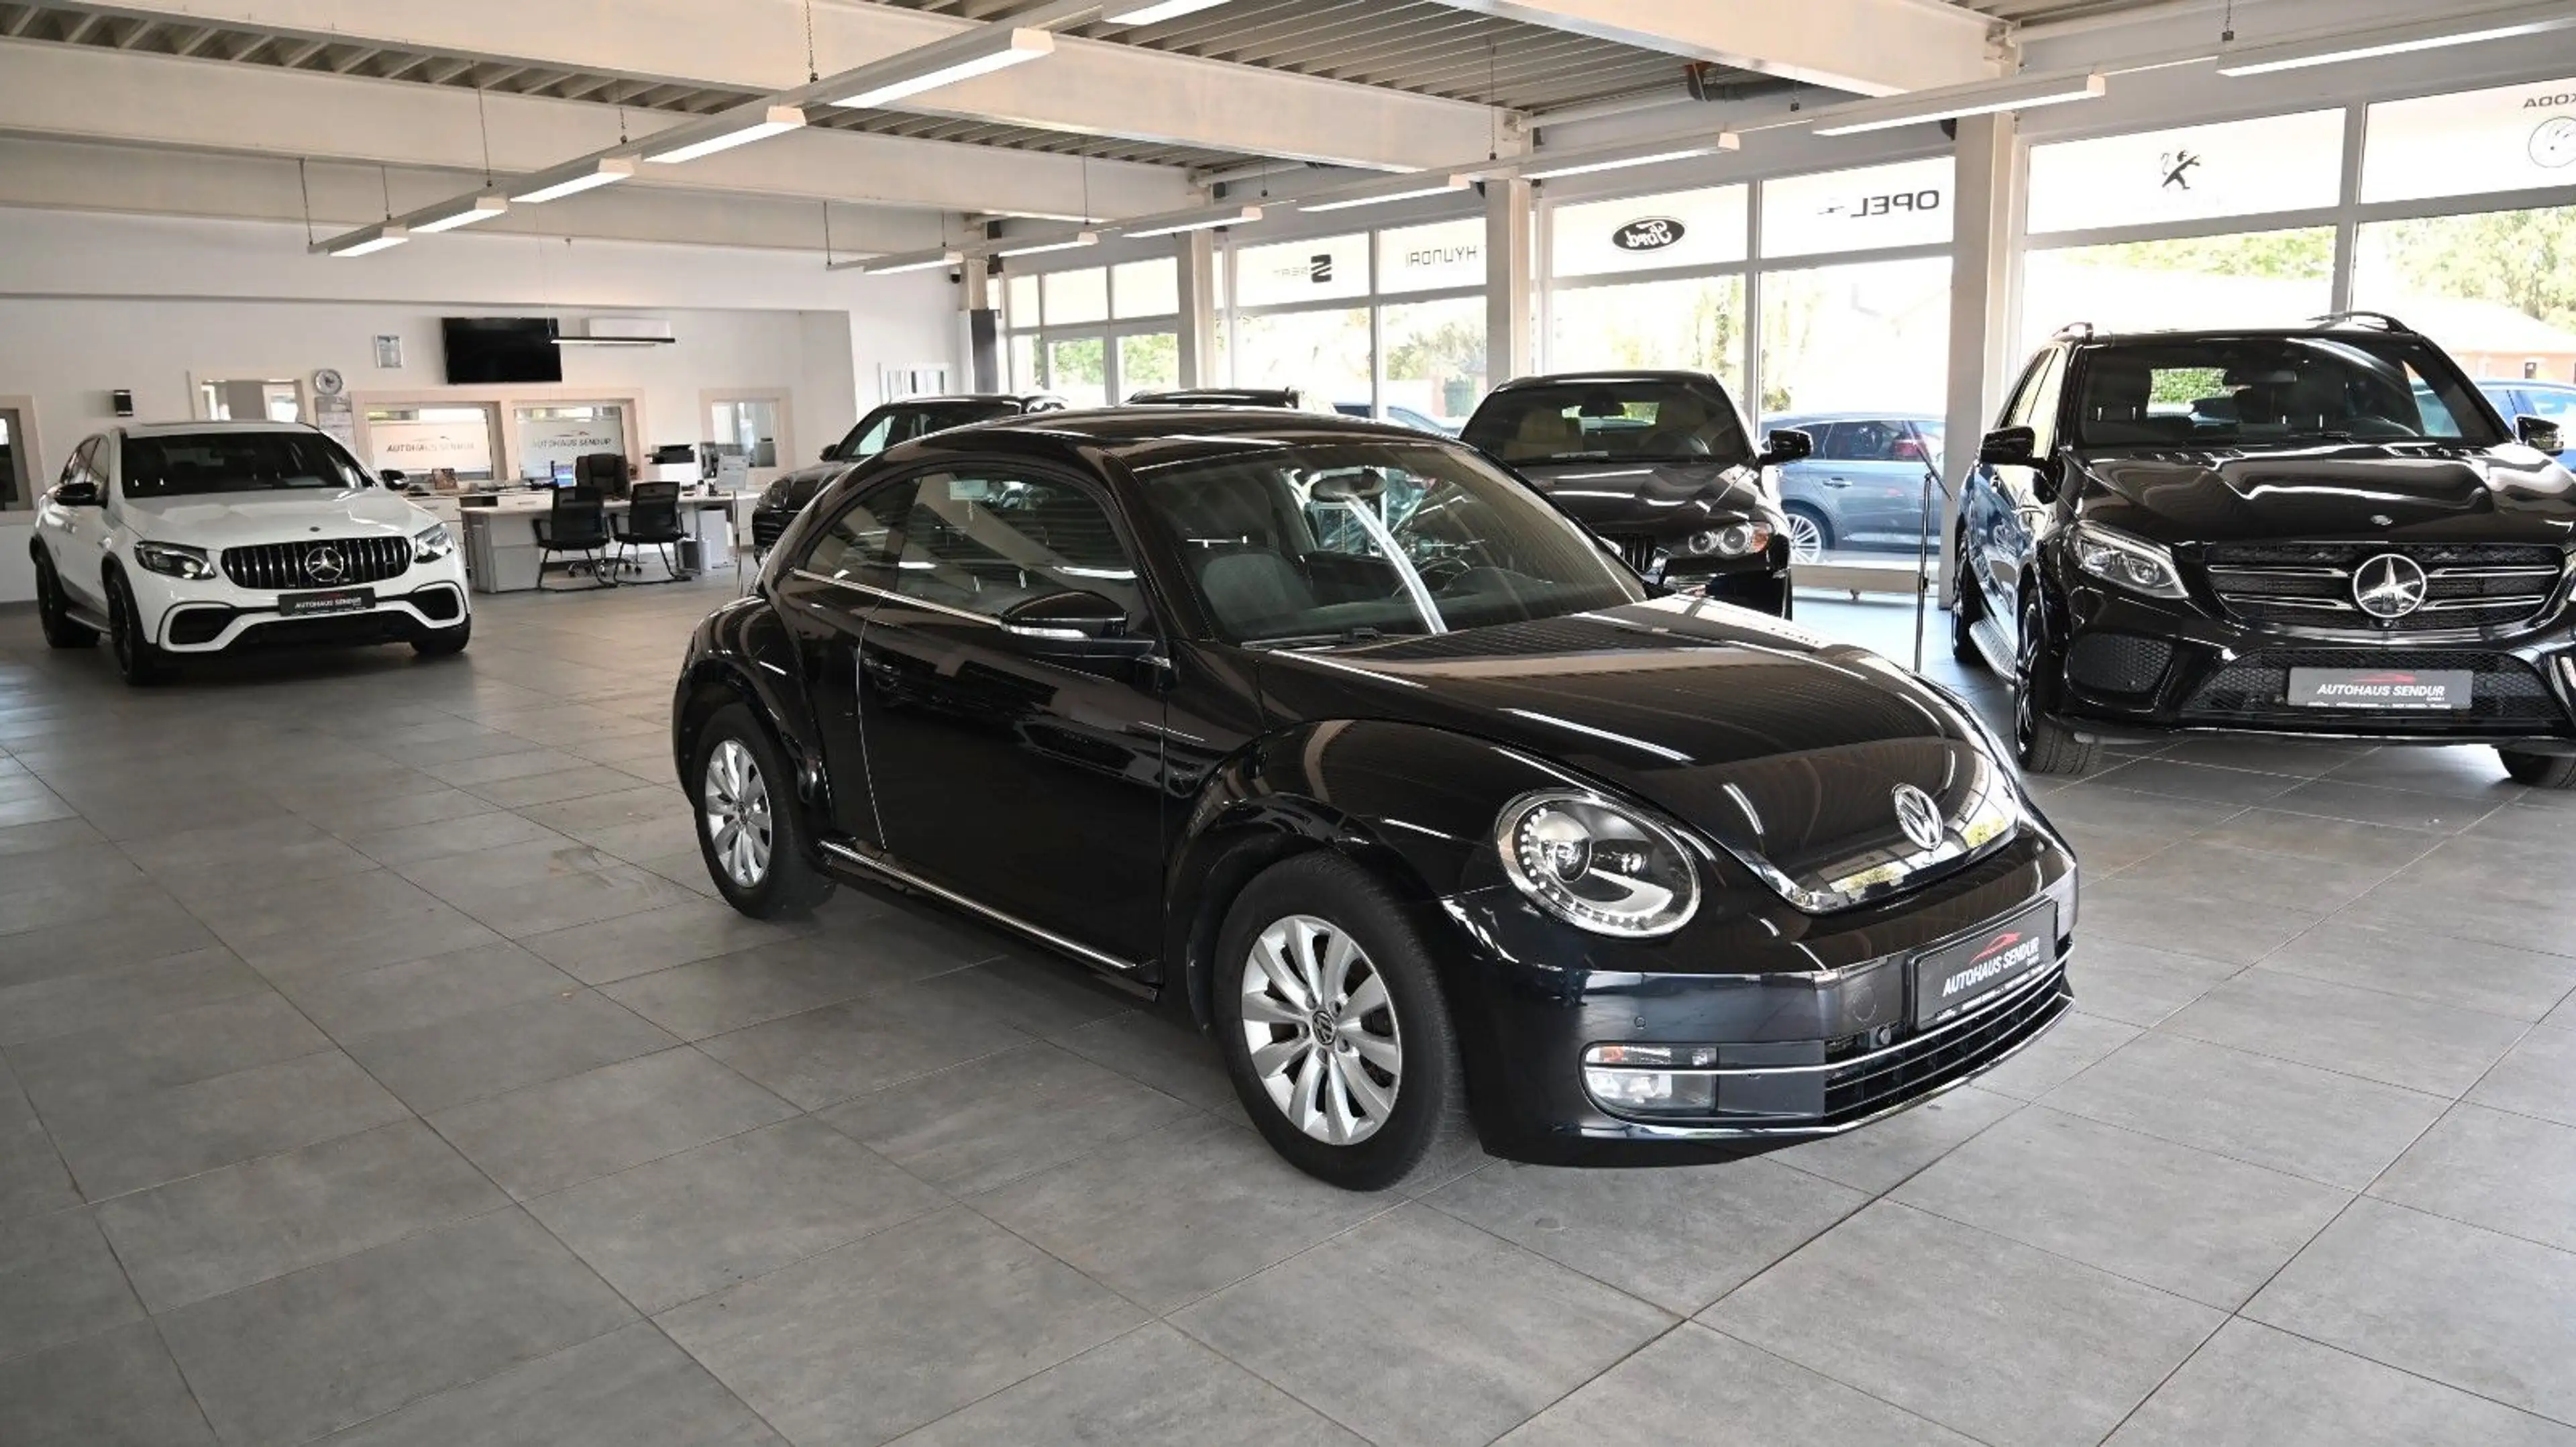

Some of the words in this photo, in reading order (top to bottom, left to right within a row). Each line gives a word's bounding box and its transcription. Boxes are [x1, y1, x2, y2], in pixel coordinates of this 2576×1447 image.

[294, 600, 333, 609] AUTOHAUS
[2317, 684, 2391, 696] AUTOHAUS
[2392, 685, 2445, 696] SENDUR
[1943, 957, 2002, 997] AUTOHAUS
[2002, 936, 2039, 969] SENDUR
